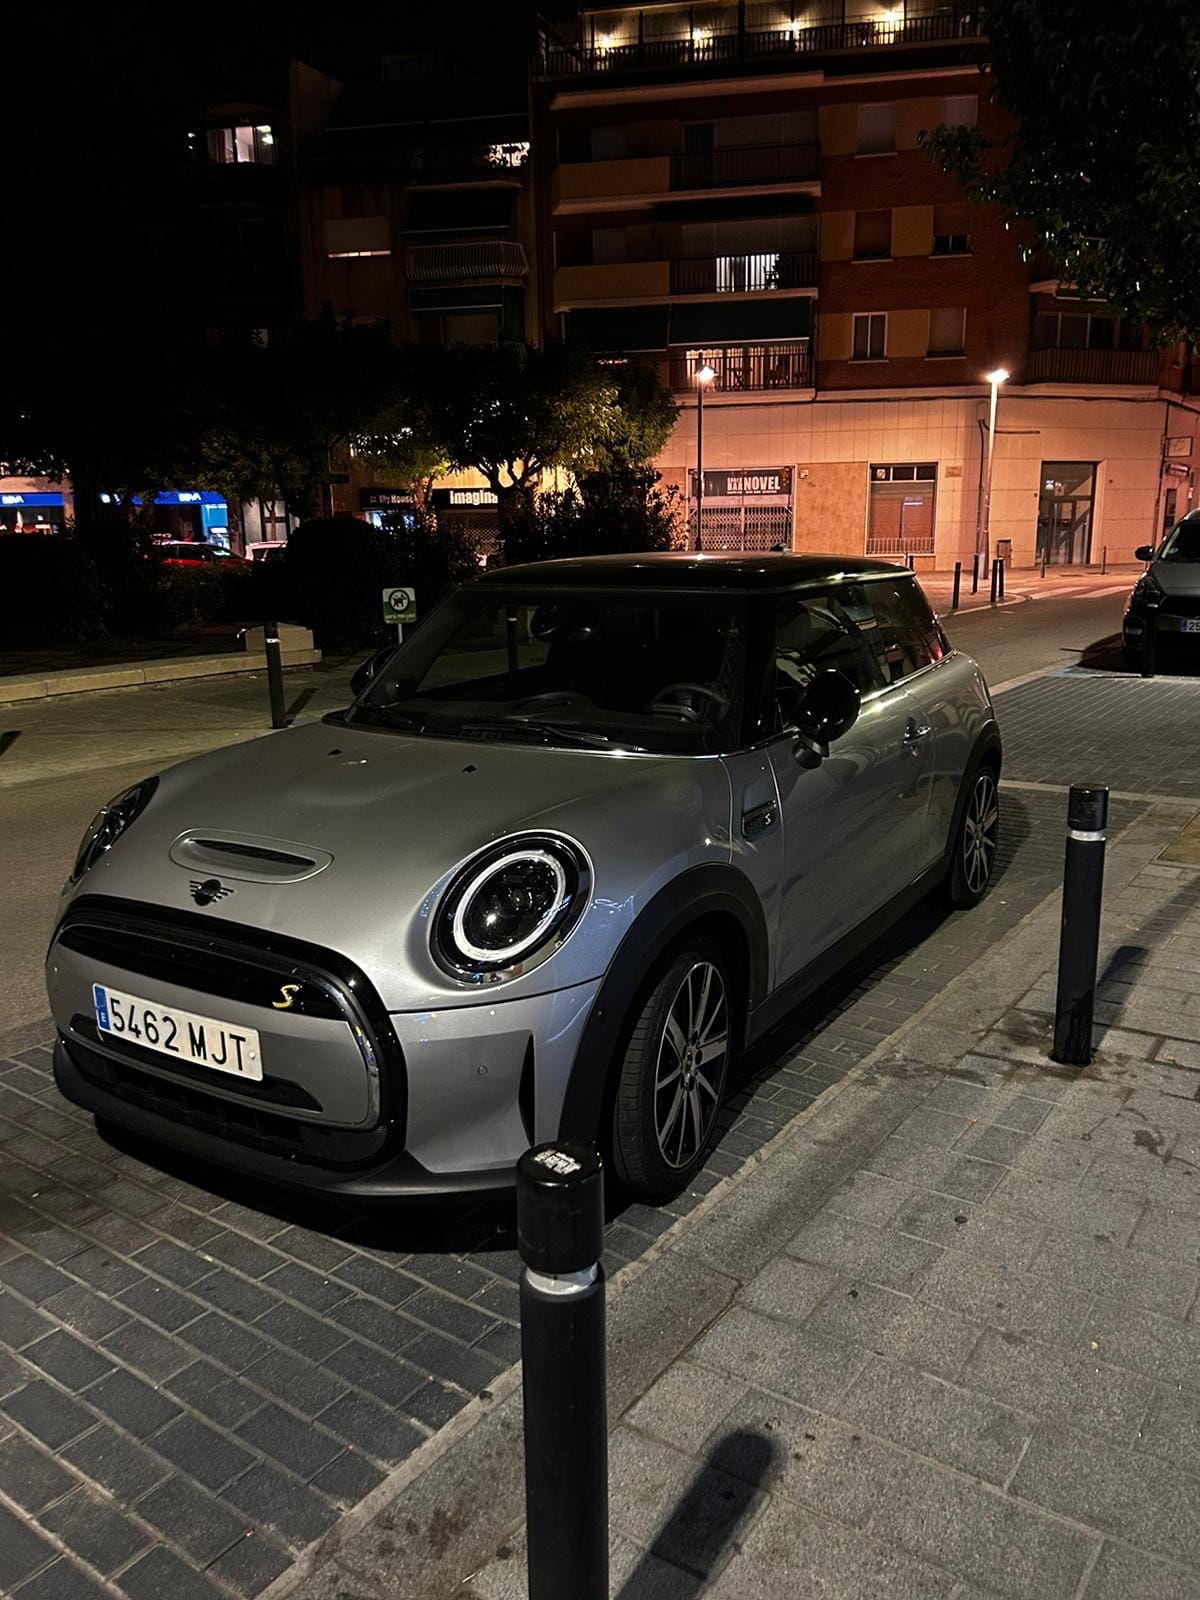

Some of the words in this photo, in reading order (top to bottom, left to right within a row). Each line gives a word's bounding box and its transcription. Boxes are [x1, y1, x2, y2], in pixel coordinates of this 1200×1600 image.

[744, 476, 780, 491] NOVEL
[449, 489, 498, 505] Imagina
[272, 984, 299, 1008] S
[110, 998, 179, 1052] 5462
[188, 1022, 246, 1071] MJT
